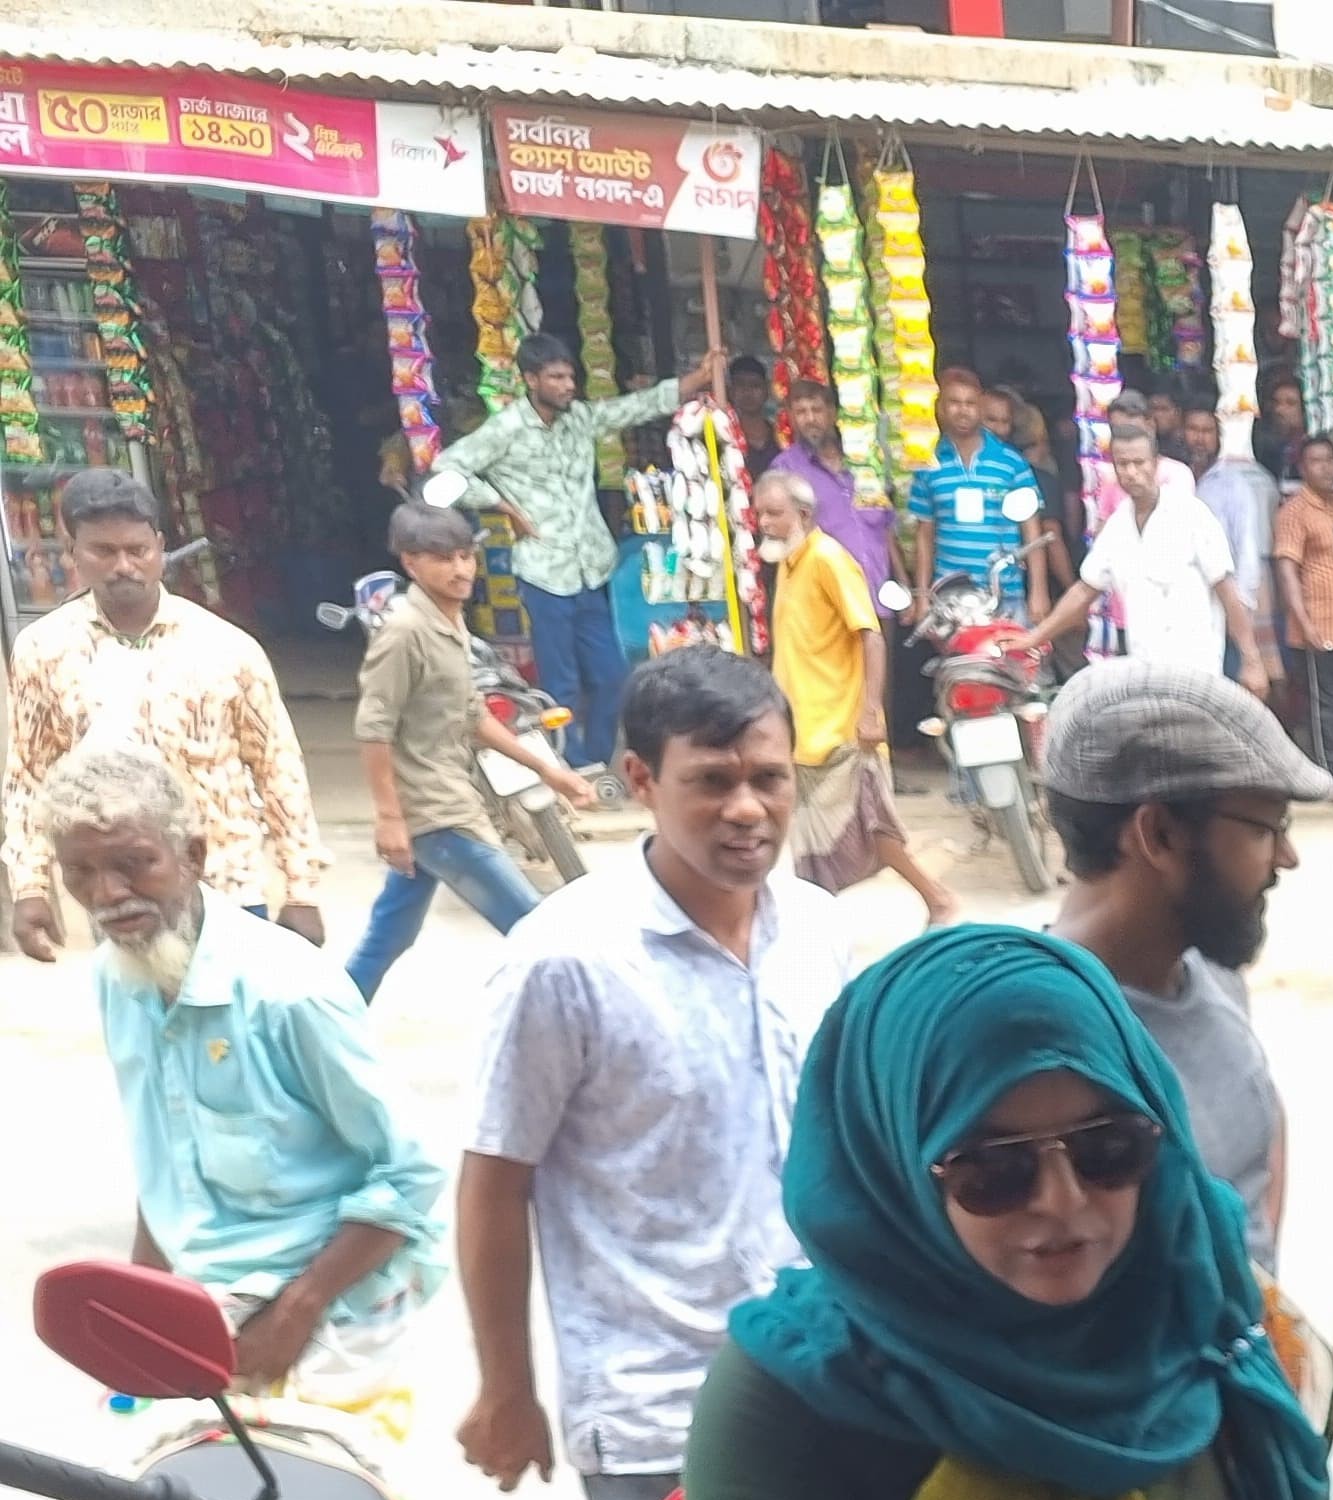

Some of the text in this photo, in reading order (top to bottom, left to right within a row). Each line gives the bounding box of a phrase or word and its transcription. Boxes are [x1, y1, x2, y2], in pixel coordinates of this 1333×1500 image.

[109, 103, 161, 120] হাজার
[178, 97, 267, 122] চার্জ হাজারে
[283, 112, 315, 161] ২
[507, 116, 591, 149] সর্বনিম্ন
[509, 143, 651, 180] ক্যাশ আউট
[574, 174, 664, 208] নগদ-এ
[694, 185, 757, 212] নগদ
